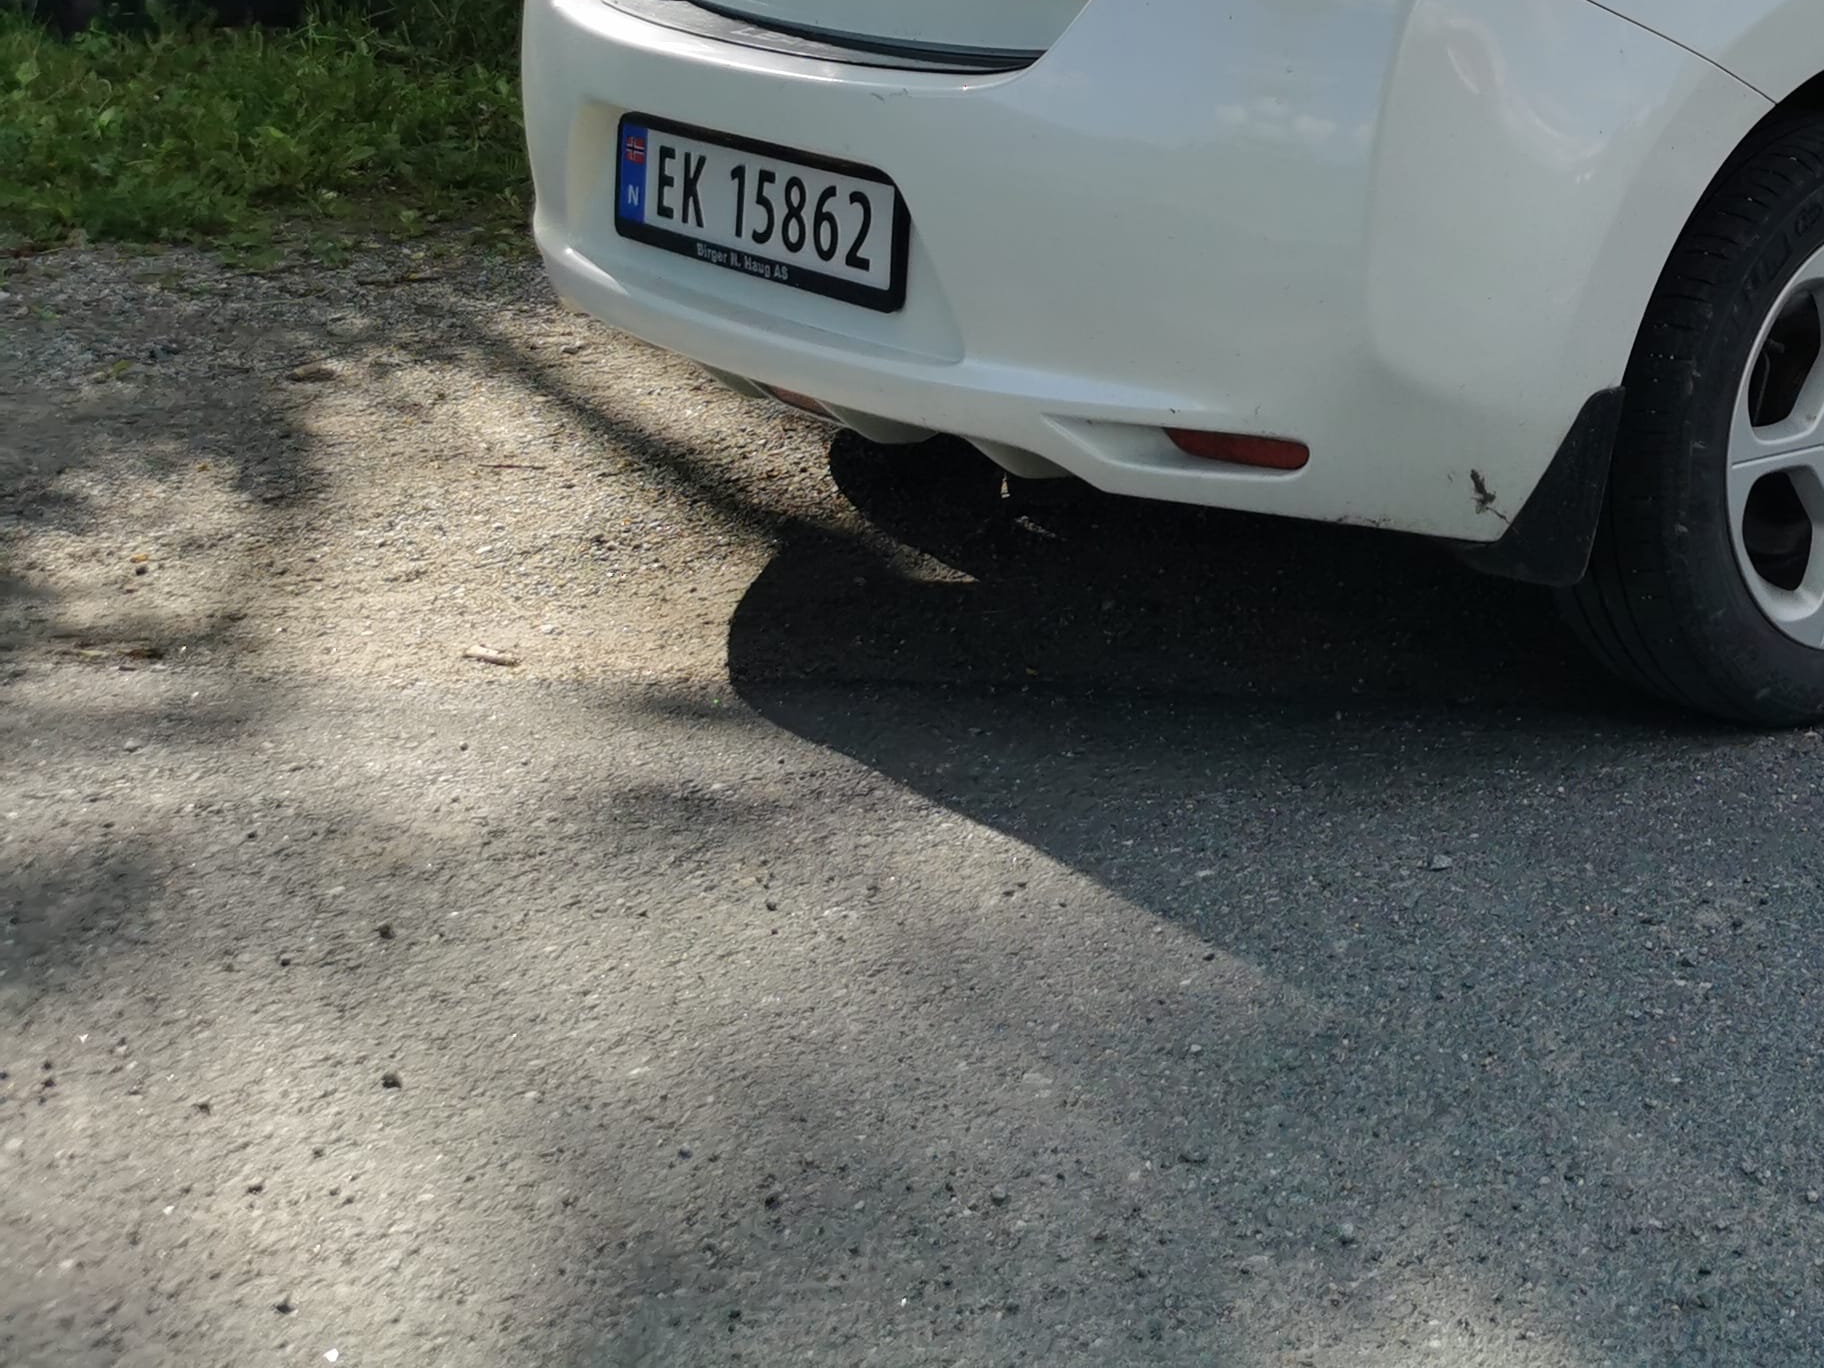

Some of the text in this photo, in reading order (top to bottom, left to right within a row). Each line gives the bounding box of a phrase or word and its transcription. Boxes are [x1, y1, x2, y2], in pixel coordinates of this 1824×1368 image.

[627, 184, 639, 206] N
[657, 145, 872, 272] EK 15862
[696, 242, 727, 264] Birger
[744, 255, 771, 279] Haug
[774, 263, 789, 282] AS
